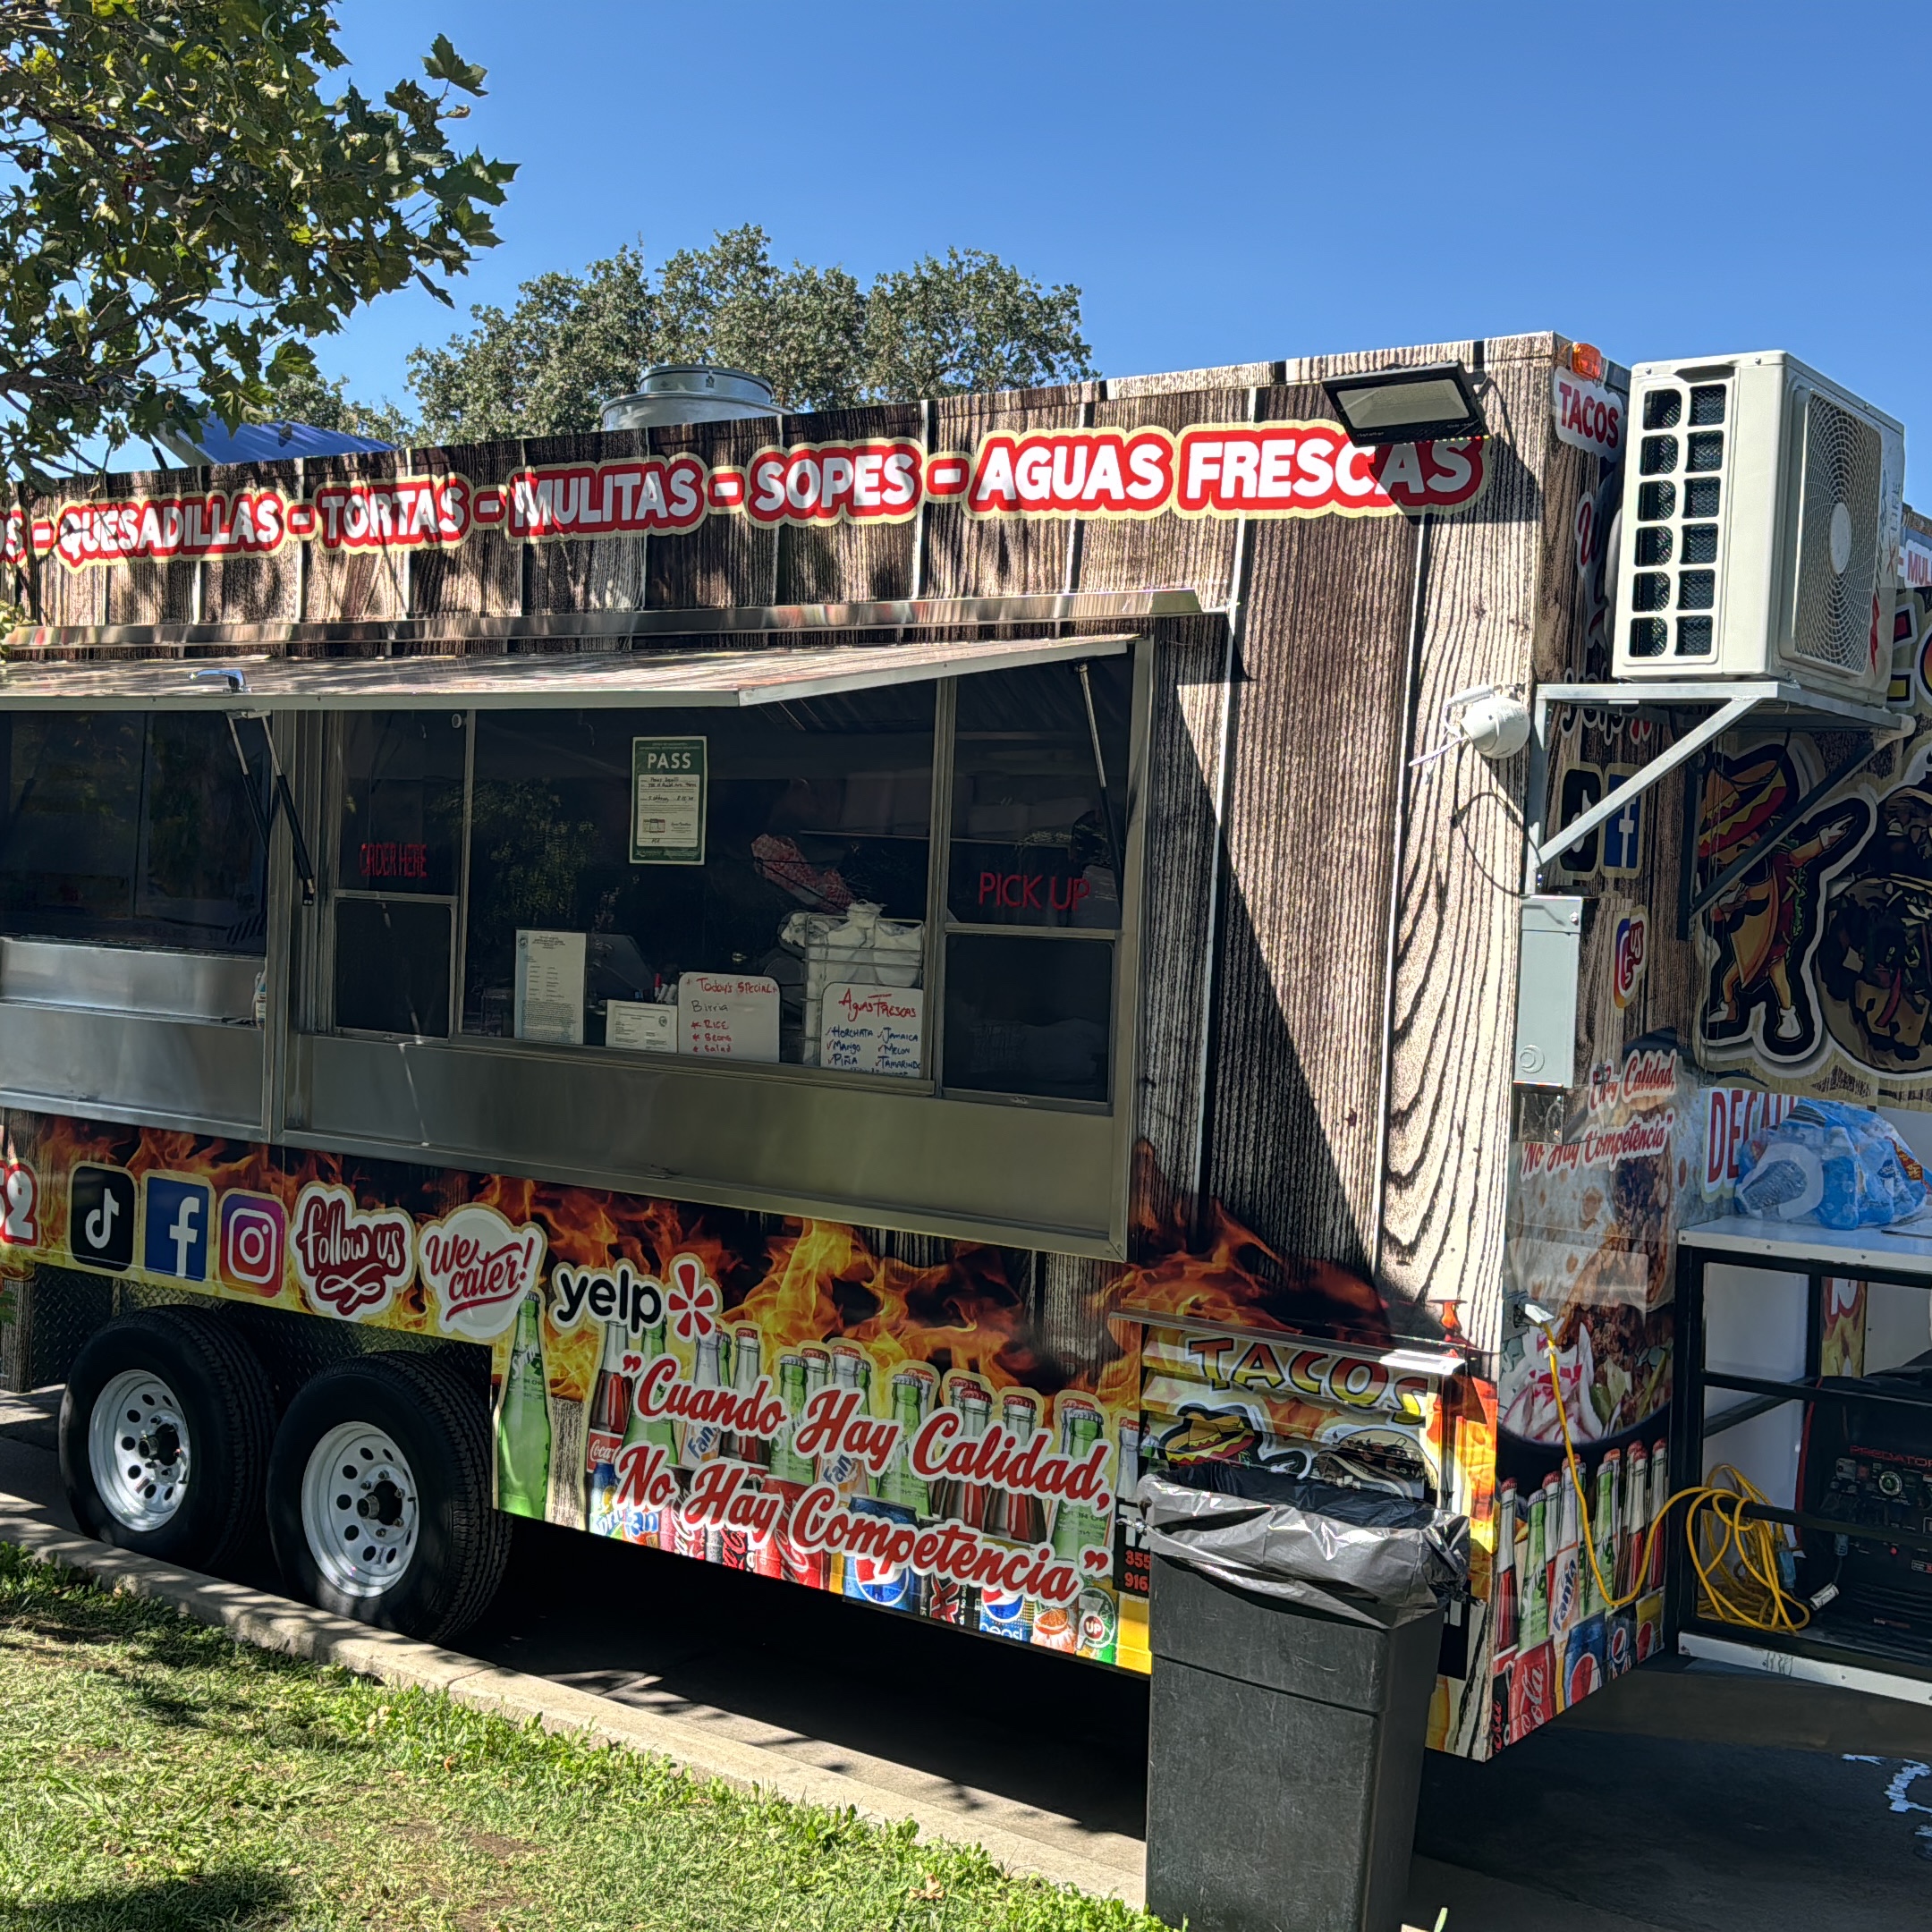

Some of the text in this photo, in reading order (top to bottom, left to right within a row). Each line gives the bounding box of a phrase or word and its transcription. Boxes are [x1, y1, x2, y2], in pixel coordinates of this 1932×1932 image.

[1559, 382, 1620, 449] TACOS
[59, 494, 281, 560] QUESADILLAS
[322, 481, 463, 539] TORTAS
[514, 468, 697, 528] MULITAS
[754, 453, 914, 511] SOPES
[981, 444, 1165, 501] AGUAS
[1187, 441, 1474, 499] FRESCAS
[647, 752, 691, 769] PASS
[979, 872, 1090, 911] PICK UP
[691, 1000, 729, 1013] Birria
[1623, 1055, 1675, 1097] Calidad,
[0, 1167, 33, 1240] 2
[301, 1203, 401, 1269] follow us
[426, 1233, 479, 1276] We
[449, 1236, 535, 1301] cater!
[556, 1268, 663, 1331] yelp
[1188, 1336, 1429, 1425] TACOS
[687, 1426, 717, 1460] Fan
[795, 1388, 899, 1471] Hay
[912, 1411, 1111, 1512] Calidad,
[616, 1445, 676, 1507] No
[684, 1462, 780, 1544] Hay
[1552, 1558, 1577, 1631] Fanta
